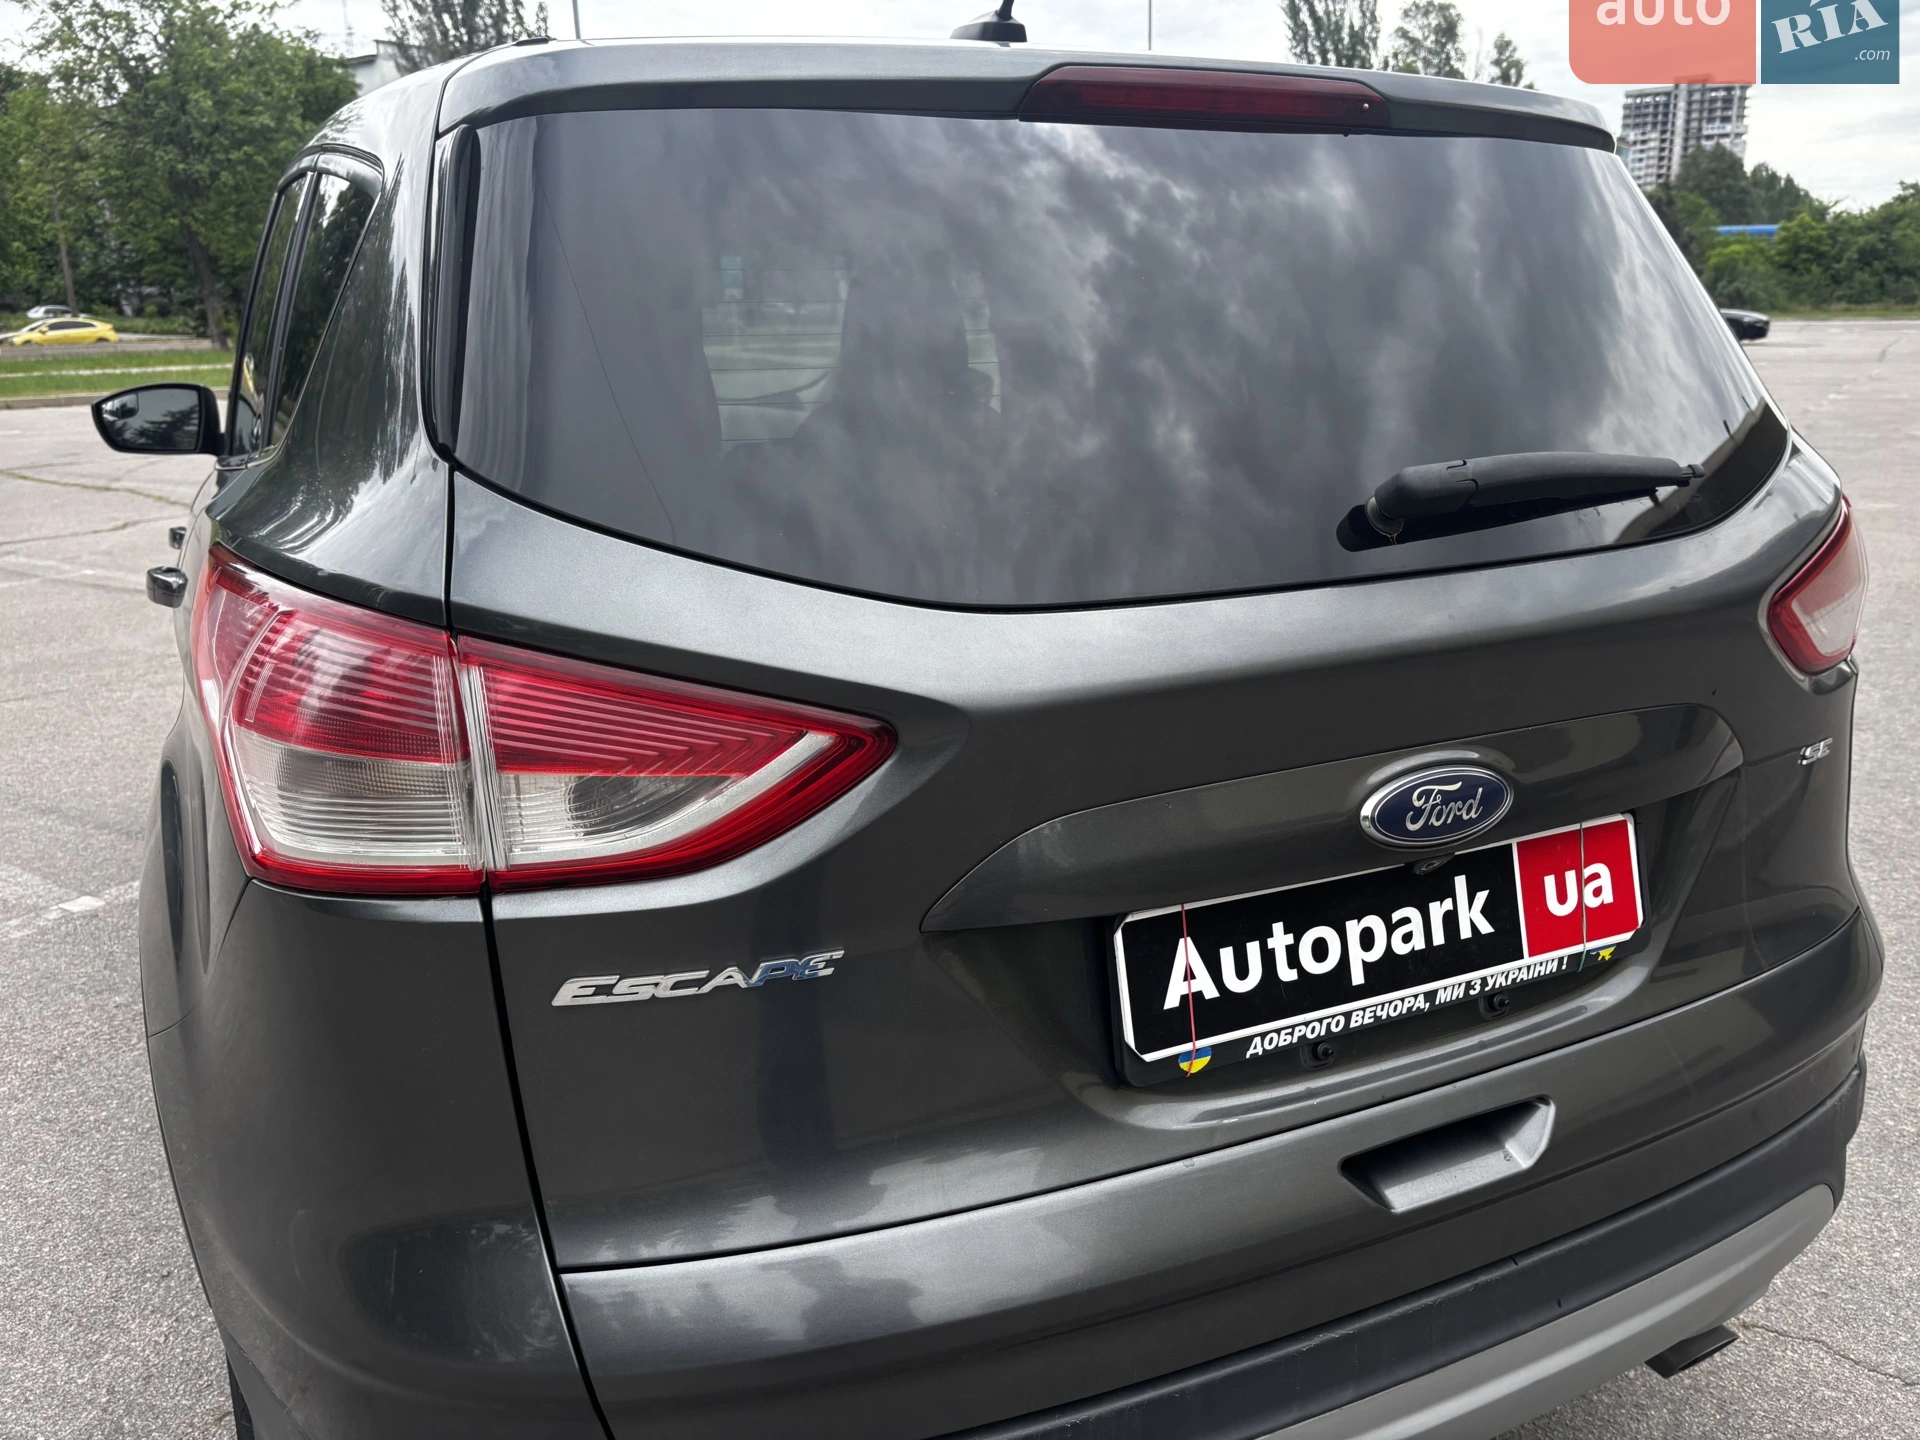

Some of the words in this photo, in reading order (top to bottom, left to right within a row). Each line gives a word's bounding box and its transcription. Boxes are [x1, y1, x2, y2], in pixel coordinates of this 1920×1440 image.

[1405, 781, 1483, 831] Ford
[1163, 875, 1495, 1010] Autopark
[1543, 862, 1614, 917] ua
[551, 949, 845, 1006] ESCAPE
[1246, 1014, 1345, 1058] ДОБРОГО
[1349, 992, 1430, 1029] ВЕЧОРА,
[1435, 981, 1466, 1005] МИ
